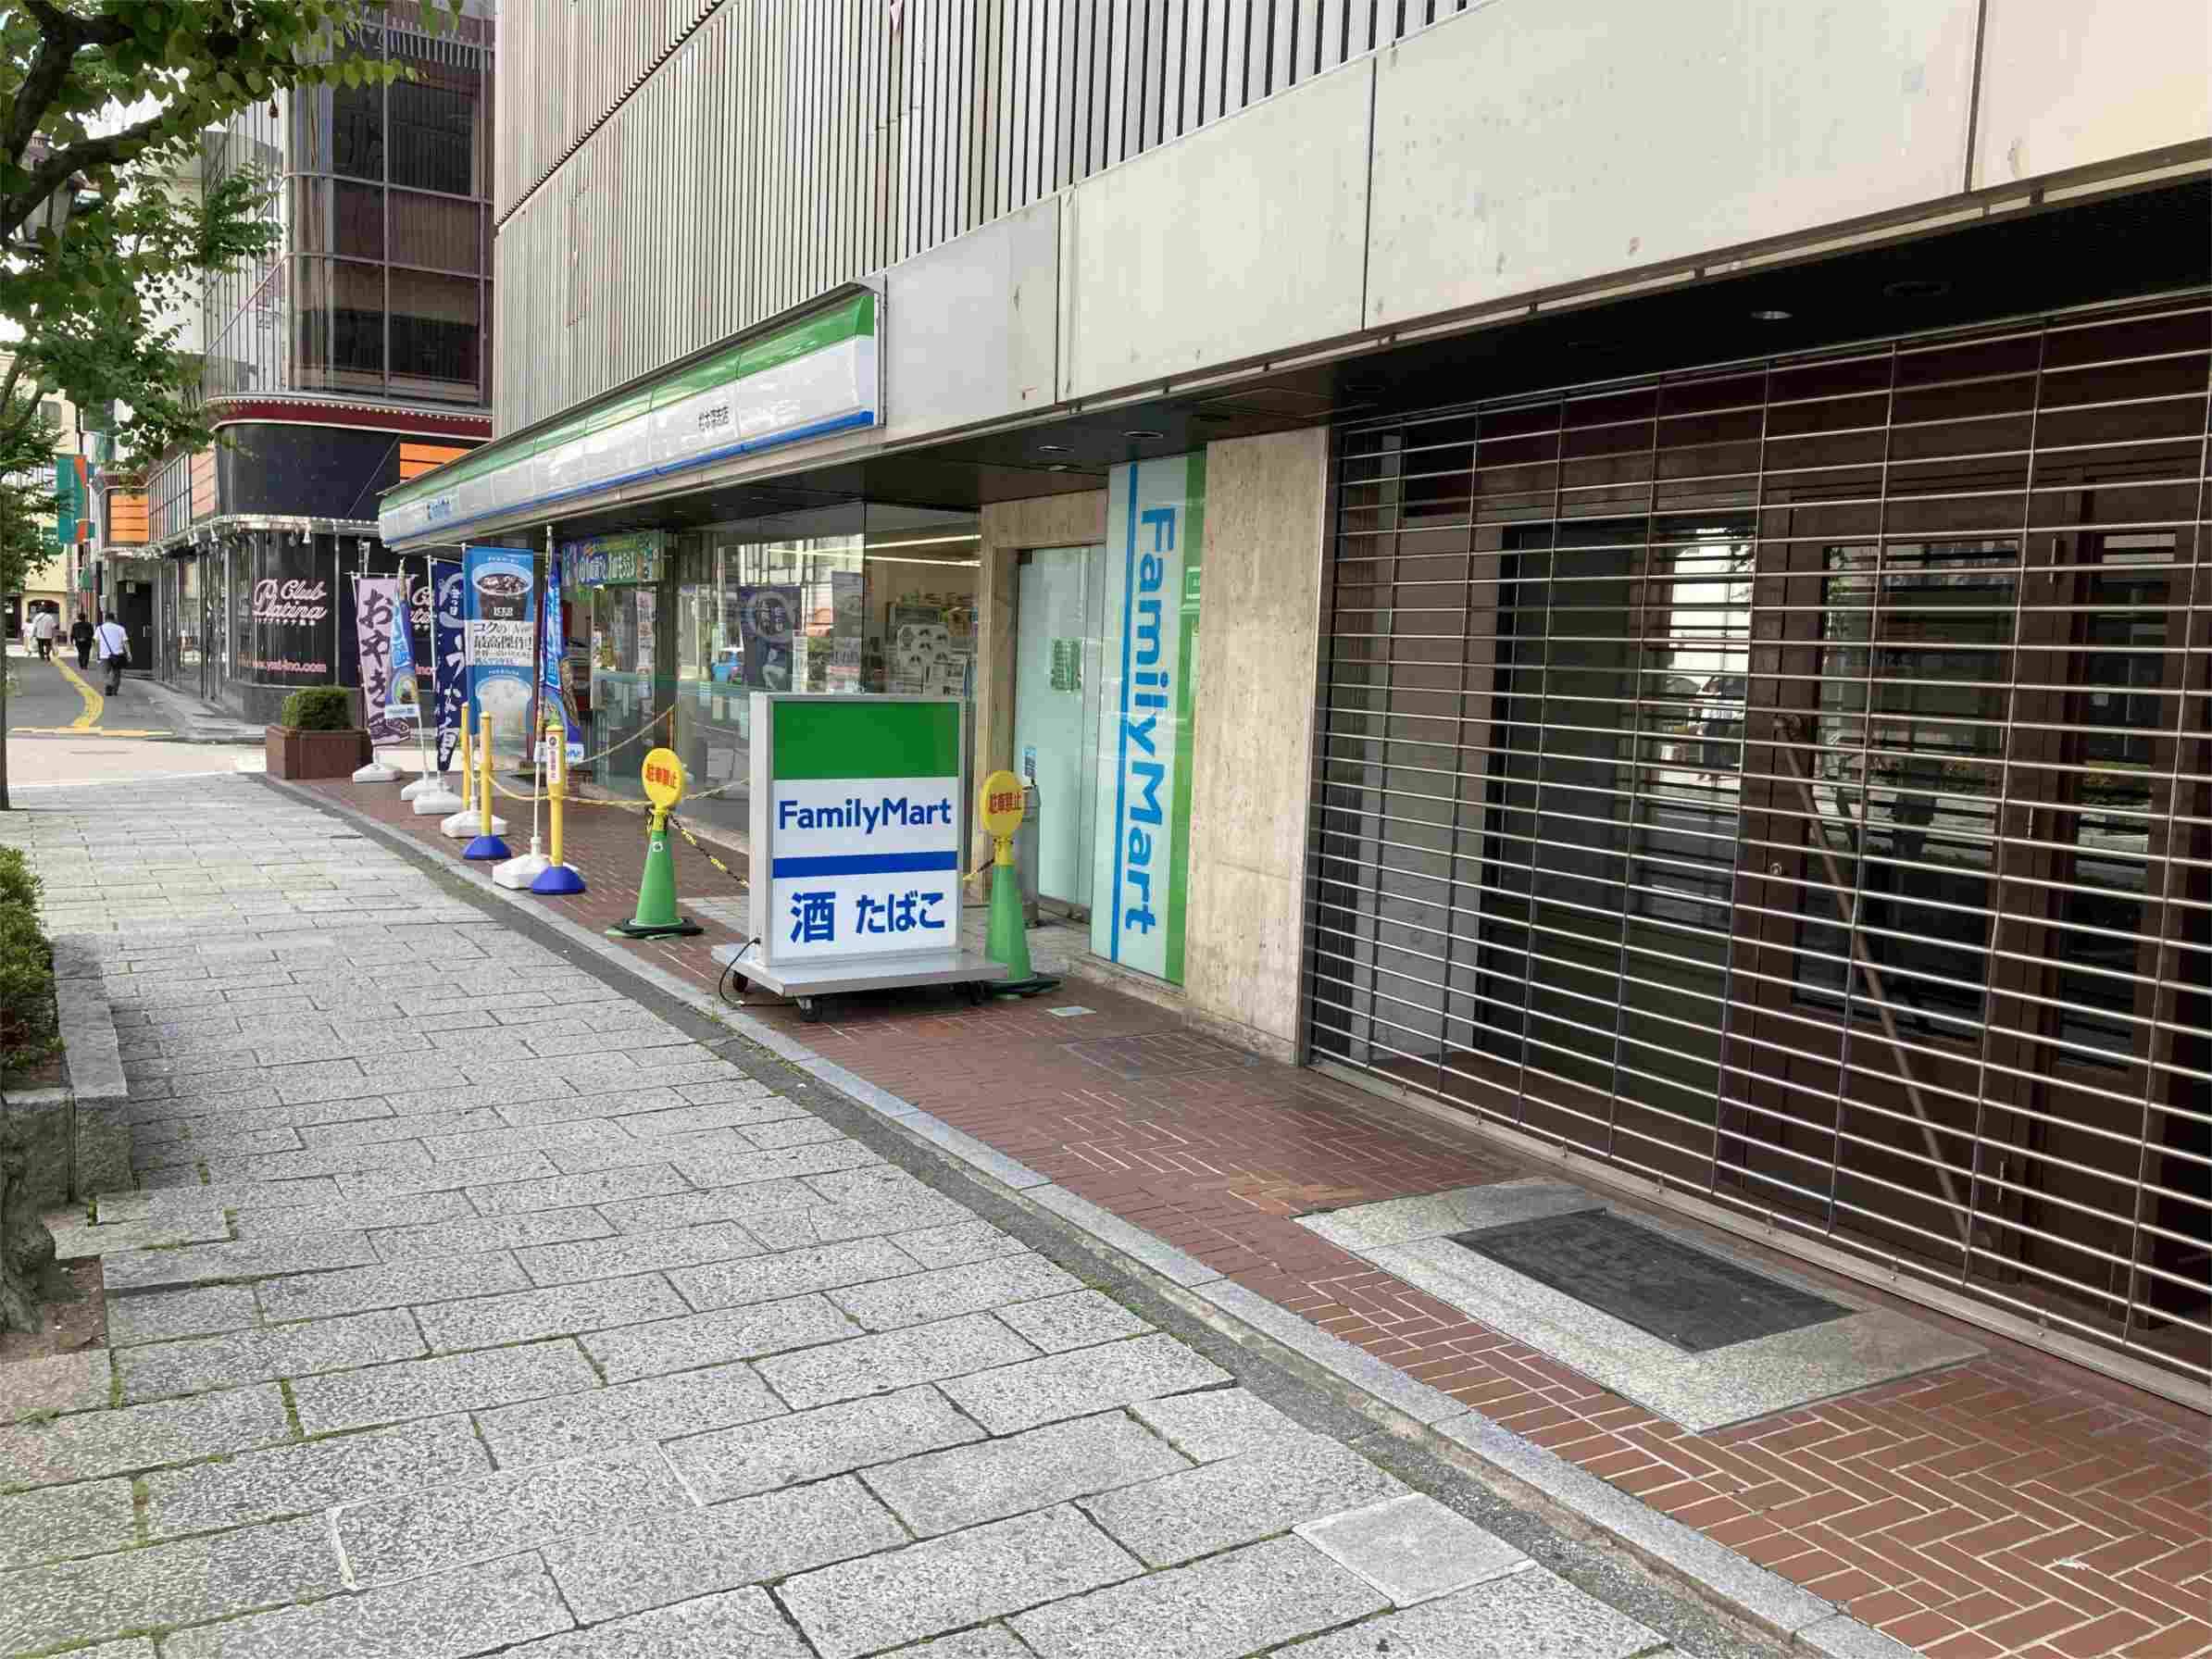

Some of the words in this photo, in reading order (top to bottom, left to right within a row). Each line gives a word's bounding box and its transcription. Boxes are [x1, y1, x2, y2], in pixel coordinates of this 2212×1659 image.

[280, 580, 327, 601] Club
[1125, 507, 1176, 934] FamilyMart
[645, 763, 677, 789] 駐車禁止
[779, 797, 952, 835] FamilyMart
[988, 792, 1023, 815] 駐車禁止
[790, 892, 836, 943] 酒
[856, 890, 945, 934] たばこ
